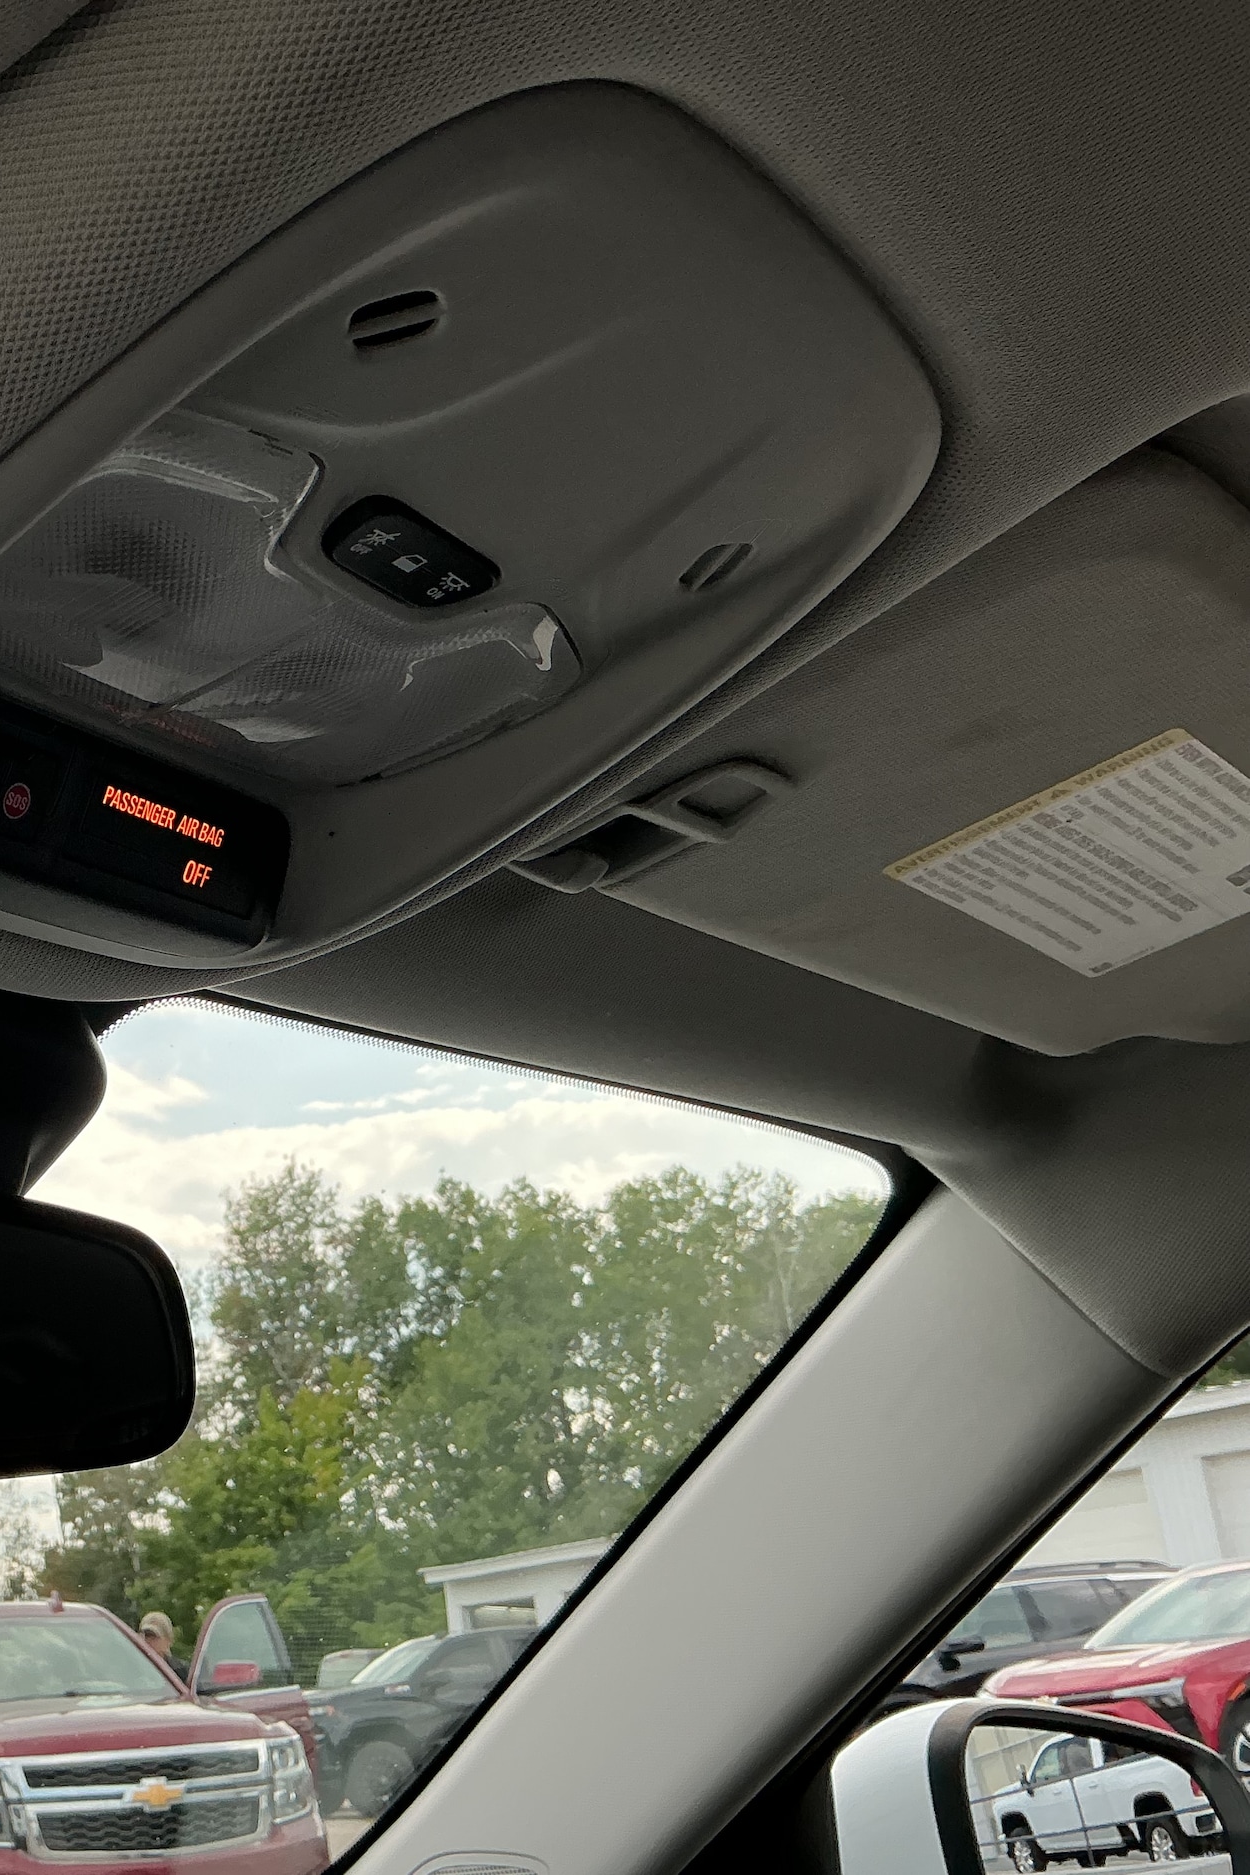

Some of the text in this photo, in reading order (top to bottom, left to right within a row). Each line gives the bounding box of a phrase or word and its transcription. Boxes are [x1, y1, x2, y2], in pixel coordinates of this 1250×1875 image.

[350, 542, 374, 555] OFF
[426, 587, 445, 600] ON
[1075, 736, 1175, 787] WARNING
[5, 790, 29, 812] SOS
[102, 785, 177, 830] PASSENGER
[182, 859, 213, 888] OFF
